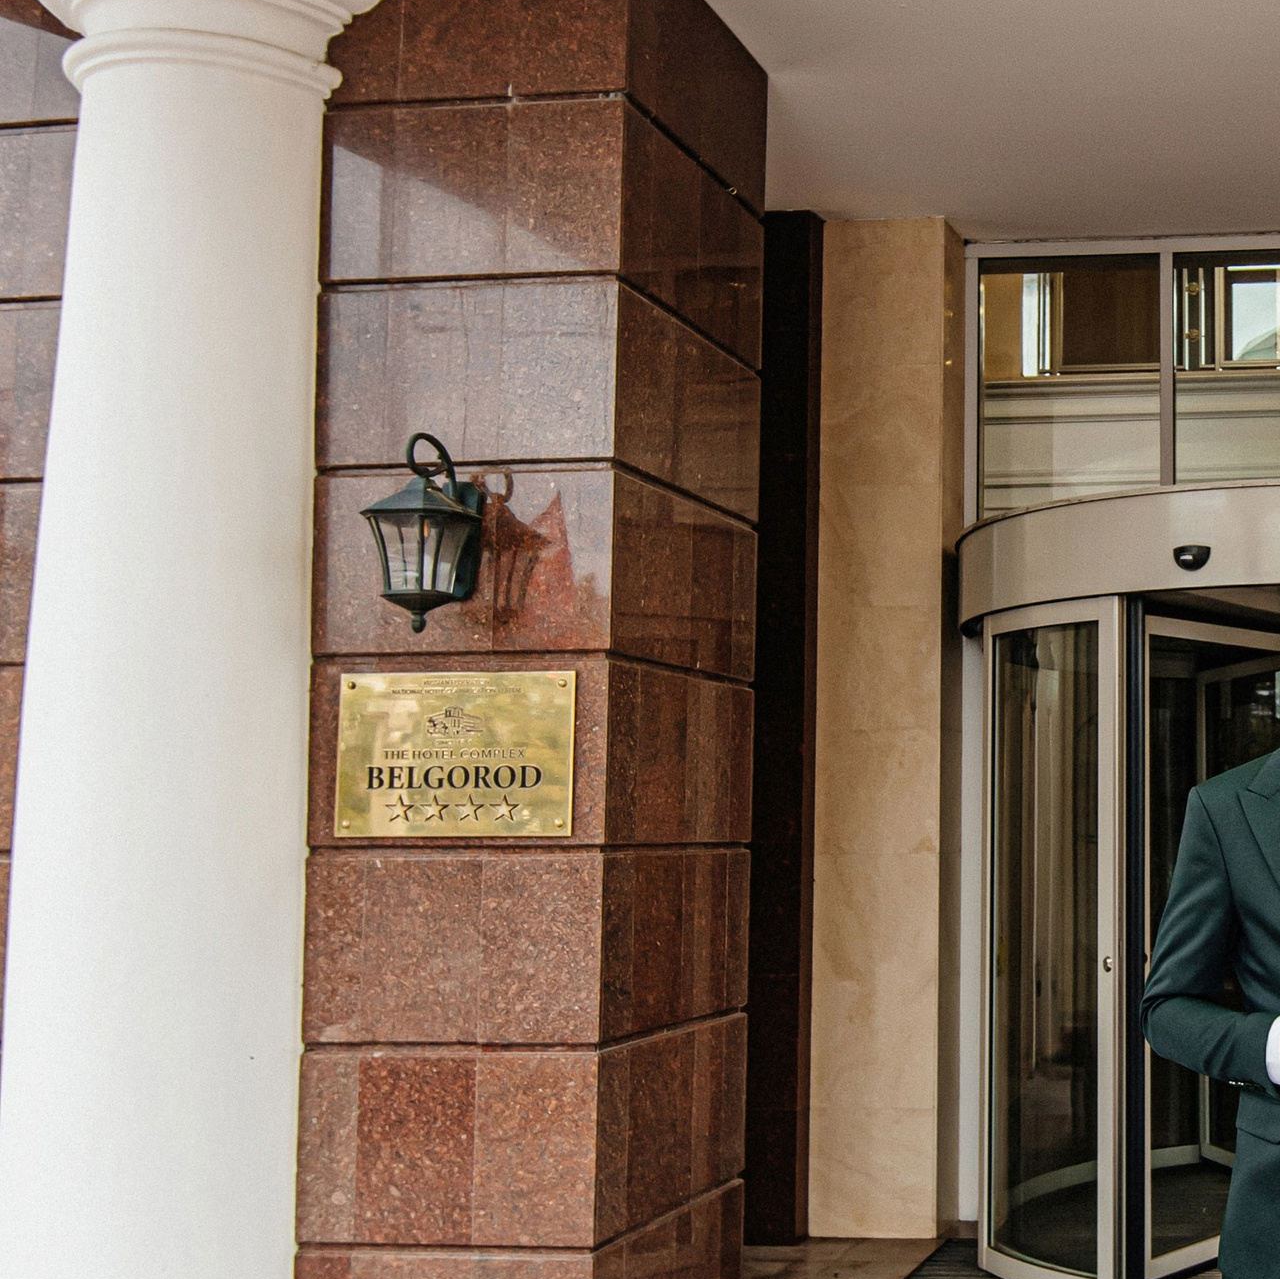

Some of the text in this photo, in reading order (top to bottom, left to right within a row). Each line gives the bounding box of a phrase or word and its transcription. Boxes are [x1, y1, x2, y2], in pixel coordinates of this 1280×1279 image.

[383, 748, 526, 760] THE HOTEL COMPLEX
[366, 764, 542, 789] BELGOROD
